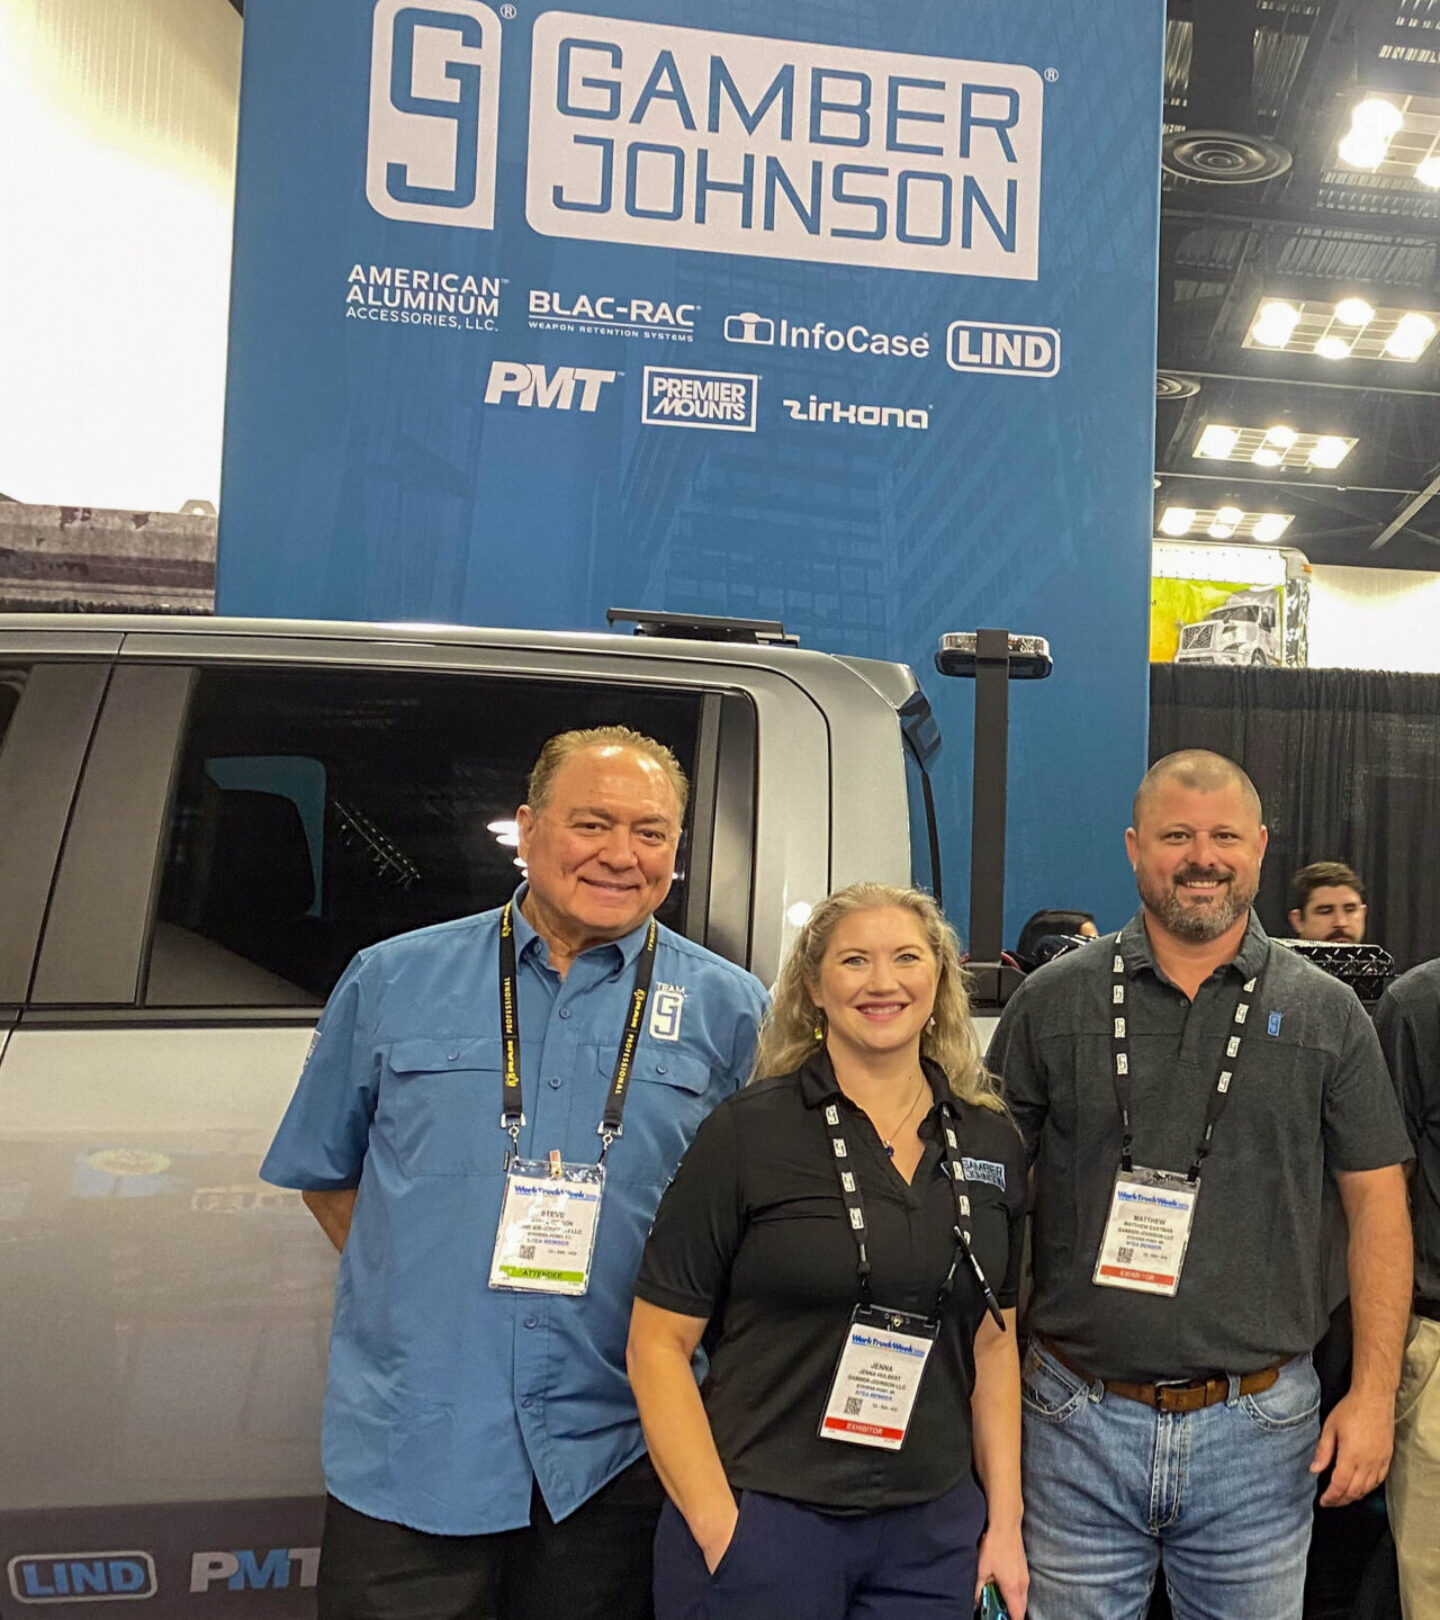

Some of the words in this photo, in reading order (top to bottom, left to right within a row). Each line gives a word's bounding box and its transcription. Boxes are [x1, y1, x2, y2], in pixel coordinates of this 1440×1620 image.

[557, 37, 1020, 163] GAMBER
[552, 134, 1018, 253] JOHNSON
[347, 264, 499, 297] AMERICAN
[345, 284, 499, 317] ALUMINUM
[529, 289, 695, 327] BLAC-RAC
[345, 307, 462, 330] ACCESSORIES,
[465, 317, 498, 332] LLC.
[528, 321, 574, 332] WEAPON
[579, 325, 639, 338] RETENTION
[643, 331, 694, 342] SYSTEMS
[780, 318, 930, 358] InfoCase
[958, 329, 1052, 368] LIND
[483, 360, 616, 412] PMT
[652, 377, 746, 403] PREMIER
[652, 396, 746, 421] MOUNTS
[783, 394, 929, 429] zirkona
[655, 981, 686, 994] TEAM
[503, 977, 513, 1034] PROFESSIONAL
[615, 1034, 635, 1095] PROFESSIONAL
[541, 1210, 566, 1219] STEVE
[1134, 1215, 1167, 1226] MATTHEW
[523, 1268, 563, 1279] ATTENDEE
[871, 1363, 893, 1372] JENNA
[22, 1561, 145, 1597] LIND
